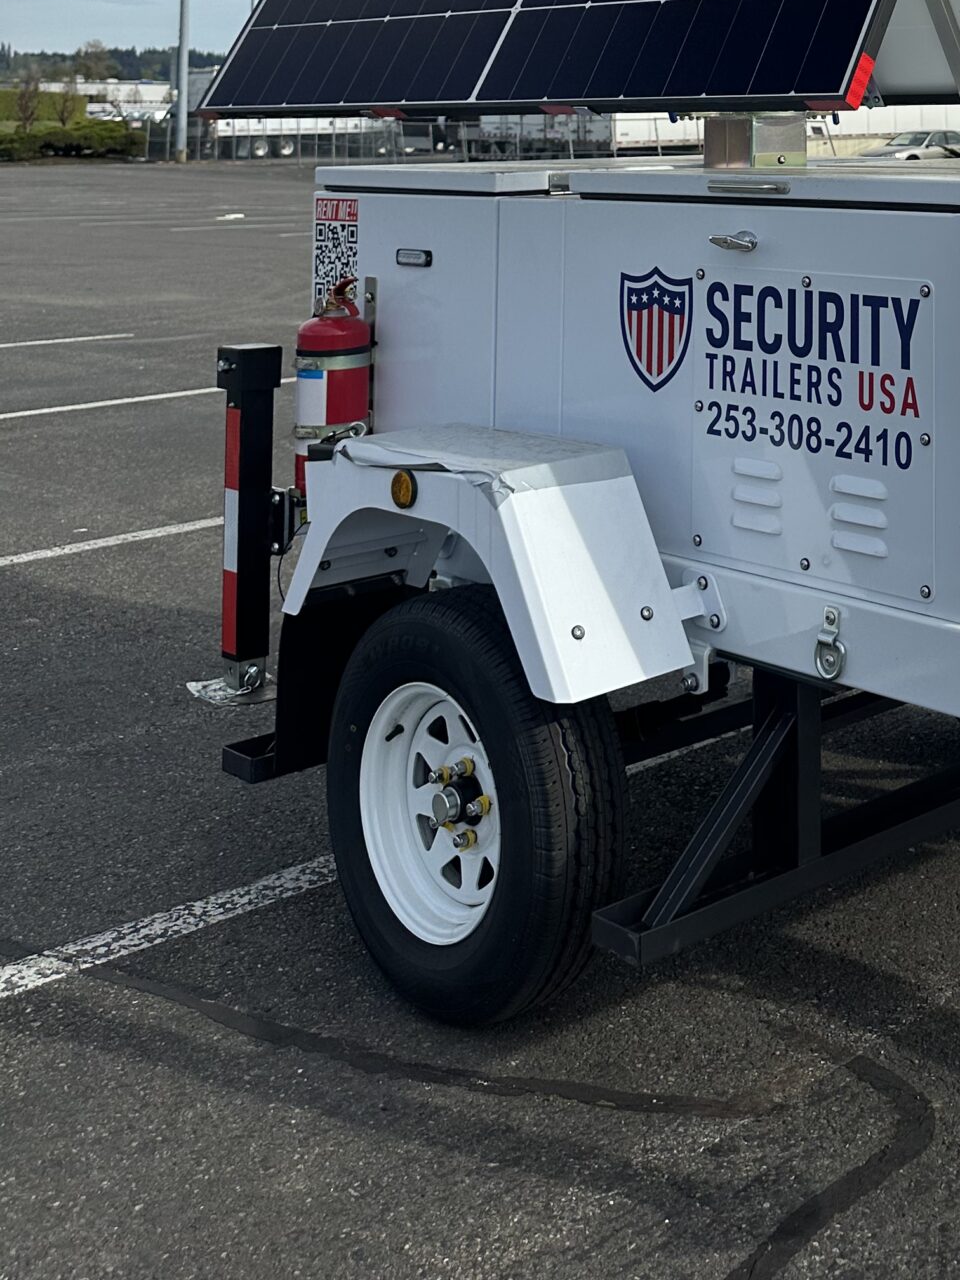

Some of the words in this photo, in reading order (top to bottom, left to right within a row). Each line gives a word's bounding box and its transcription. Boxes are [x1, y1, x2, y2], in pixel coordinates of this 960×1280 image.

[317, 200, 338, 219] RENT
[338, 200, 358, 220] ME!!
[705, 281, 920, 370] SECURITY
[705, 352, 843, 407] TRAILERS
[858, 370, 920, 418] USA
[706, 400, 913, 470] 253-308-2410
